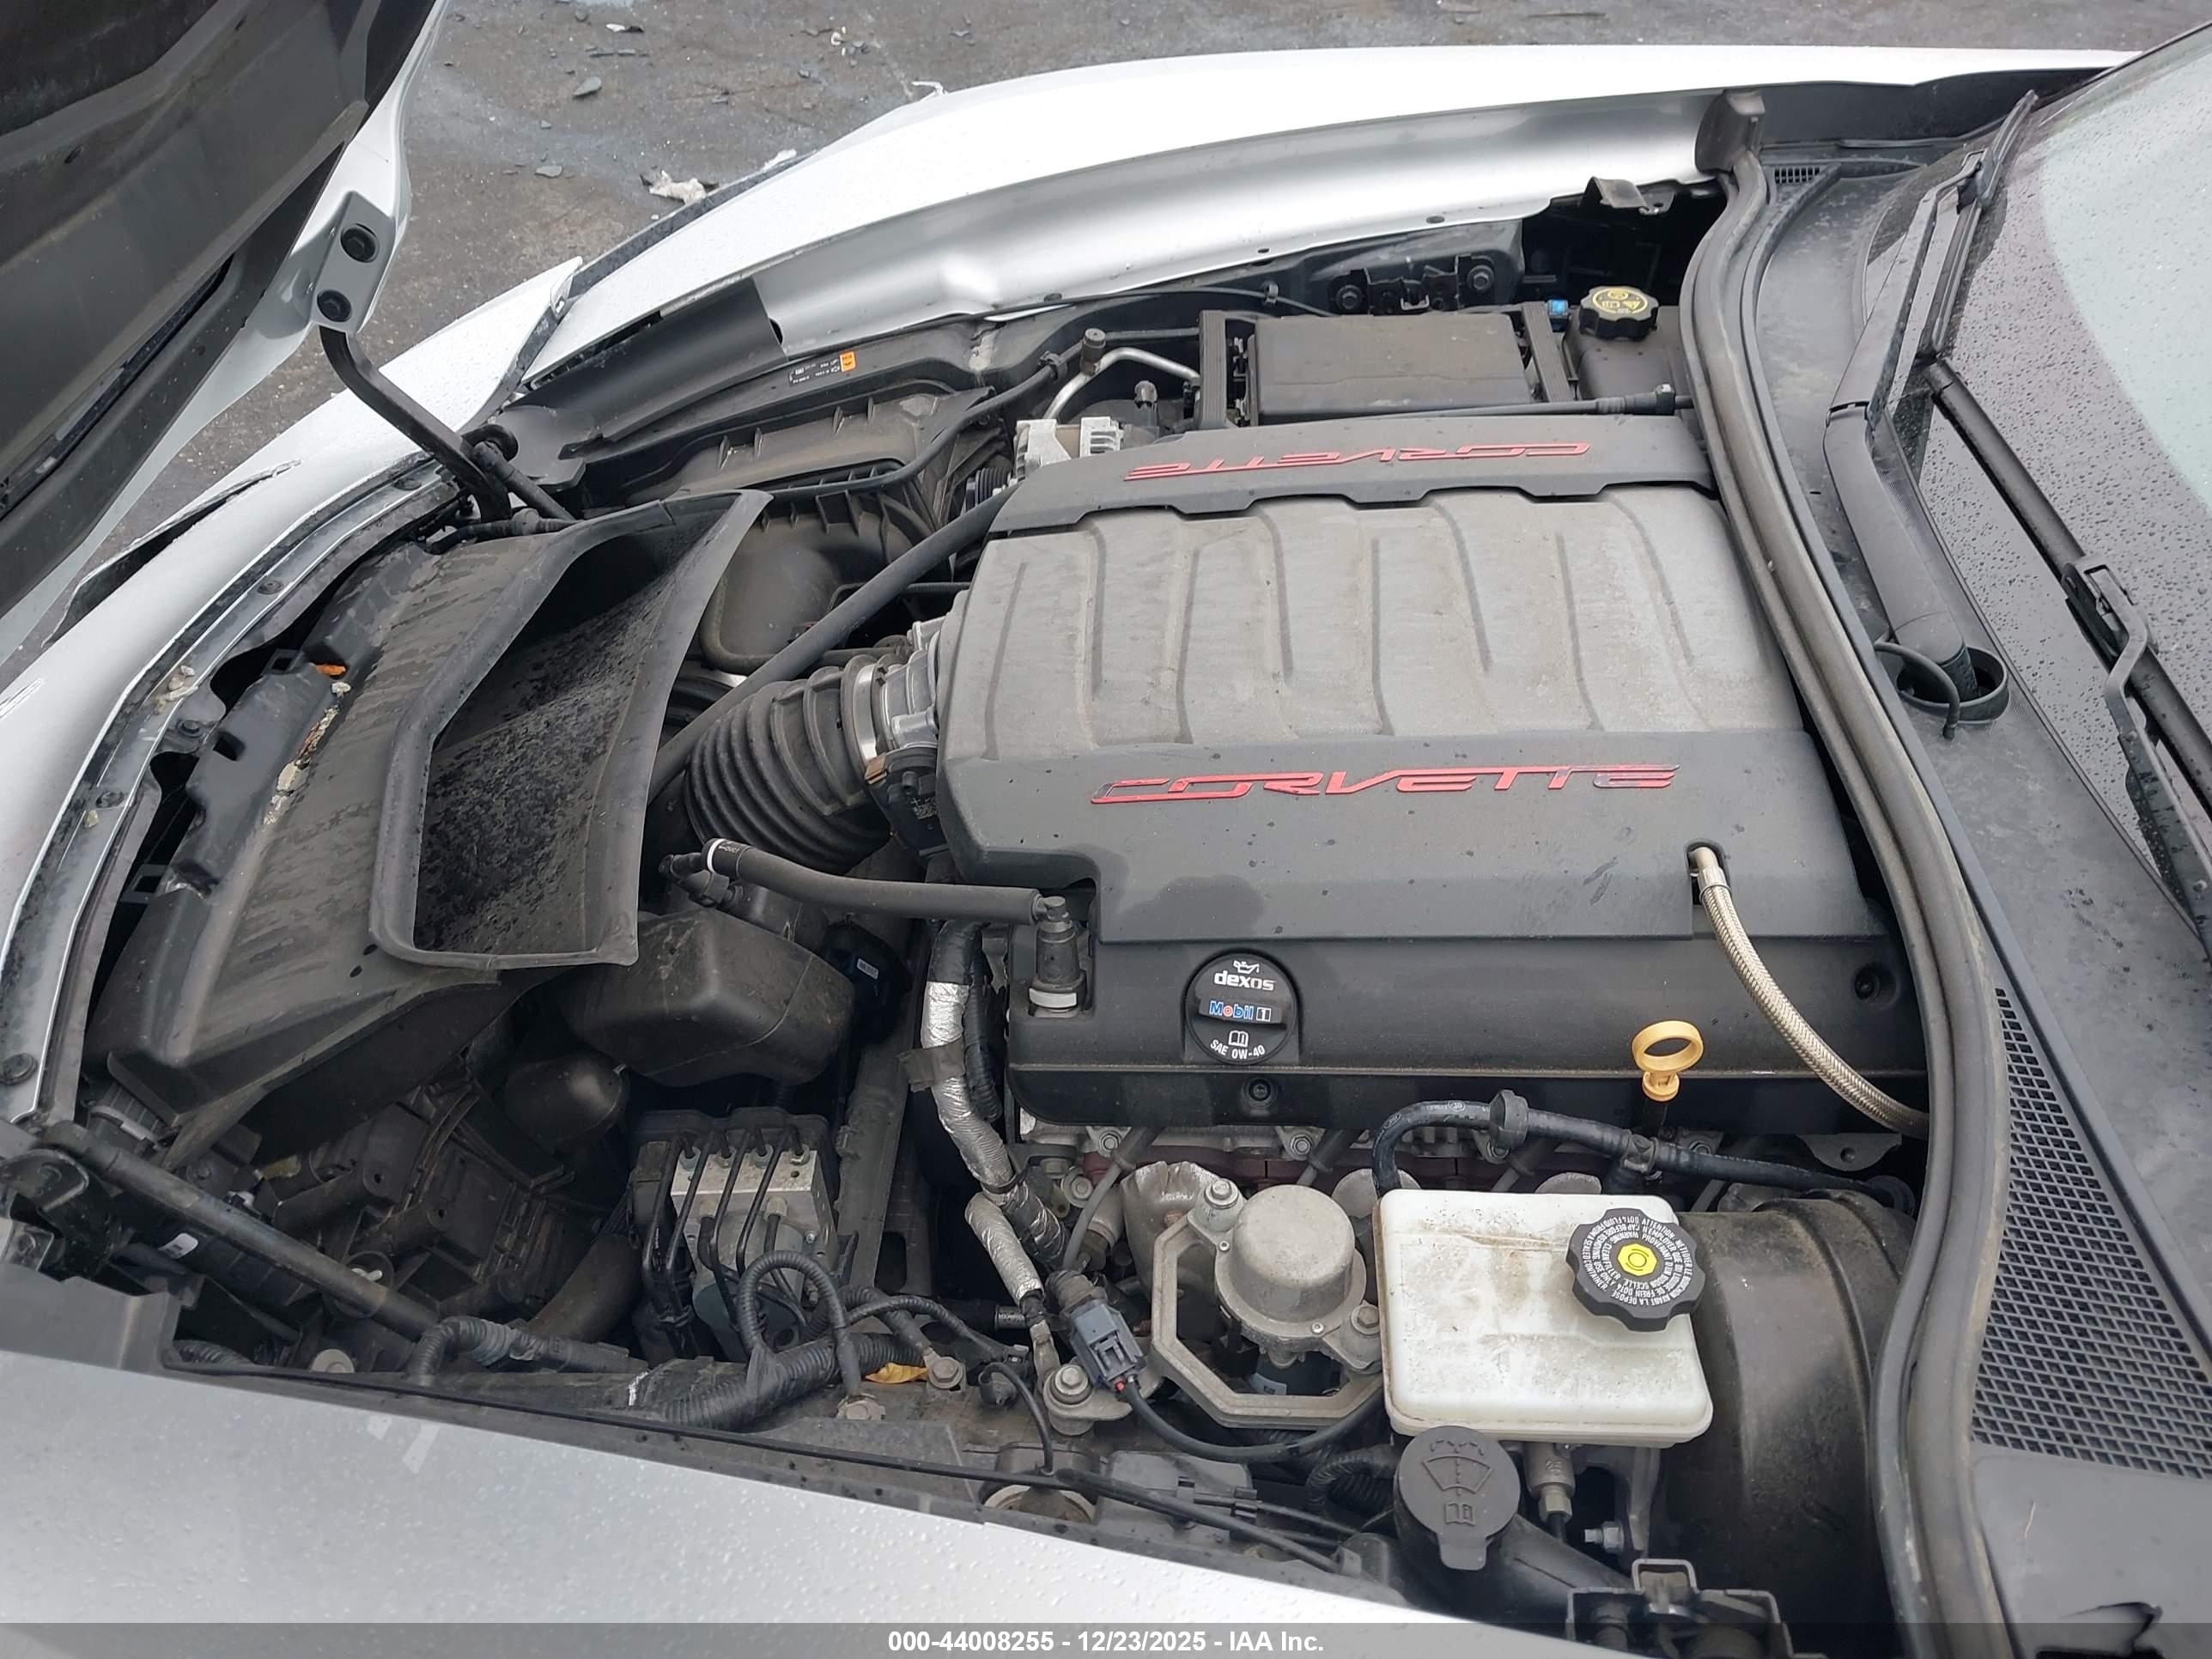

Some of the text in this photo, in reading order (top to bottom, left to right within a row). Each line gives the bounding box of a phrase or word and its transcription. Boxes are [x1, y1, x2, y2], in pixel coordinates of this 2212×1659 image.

[1123, 443, 1591, 481] CORVETTE
[1091, 765, 1680, 804] CORVETTE
[1214, 970, 1276, 991] dexos
[1209, 1000, 1254, 1019] Mobil
[1210, 1040, 1266, 1060] SAE 0W-40
